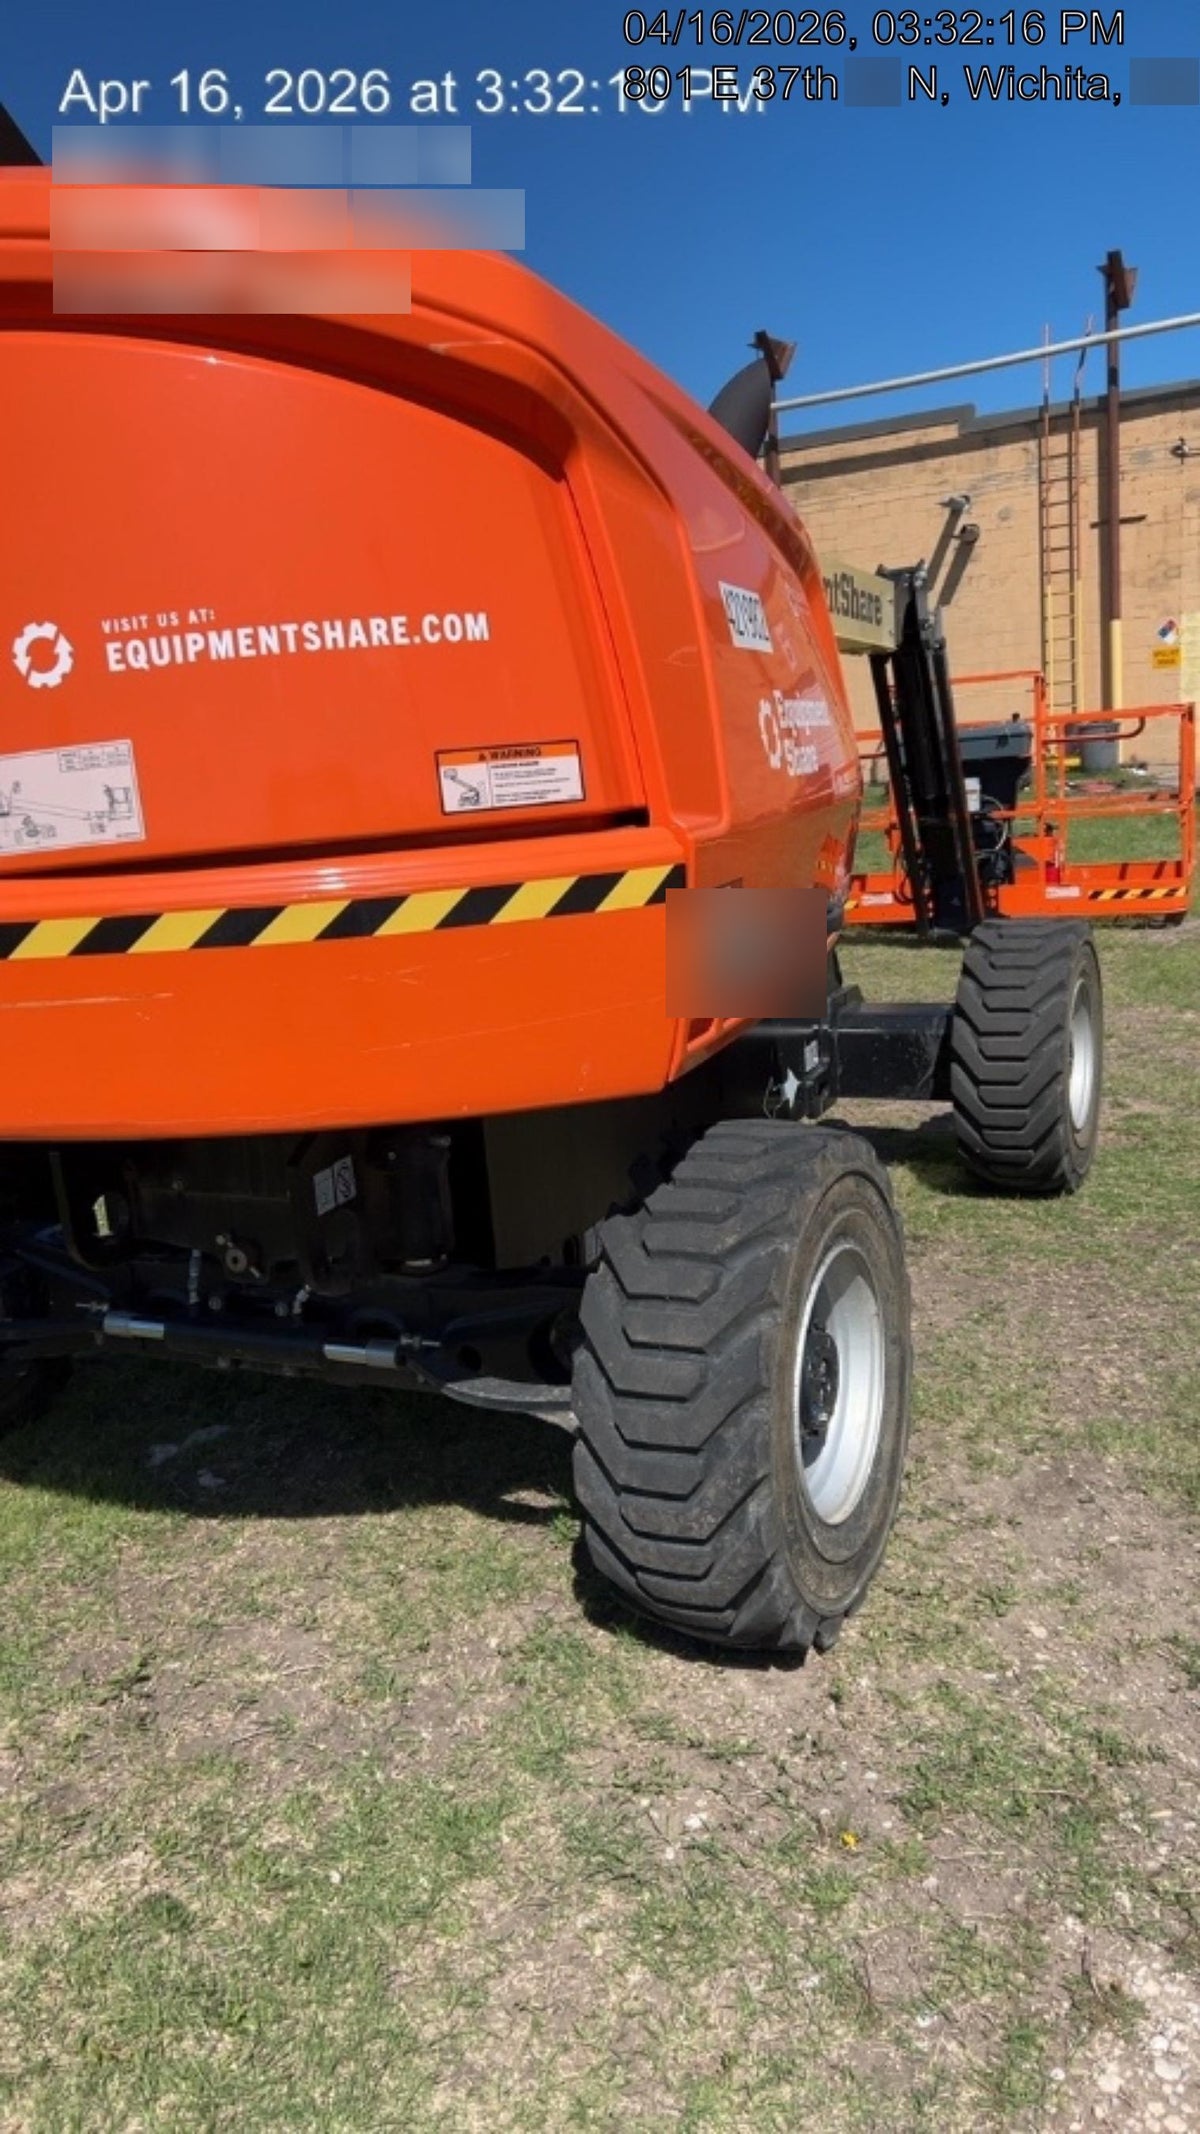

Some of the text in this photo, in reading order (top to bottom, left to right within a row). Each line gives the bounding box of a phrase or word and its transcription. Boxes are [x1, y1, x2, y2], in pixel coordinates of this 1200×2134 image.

[101, 608, 216, 634] VISIT US AT:
[106, 612, 490, 672] EQUIPMENTSHARE.COM
